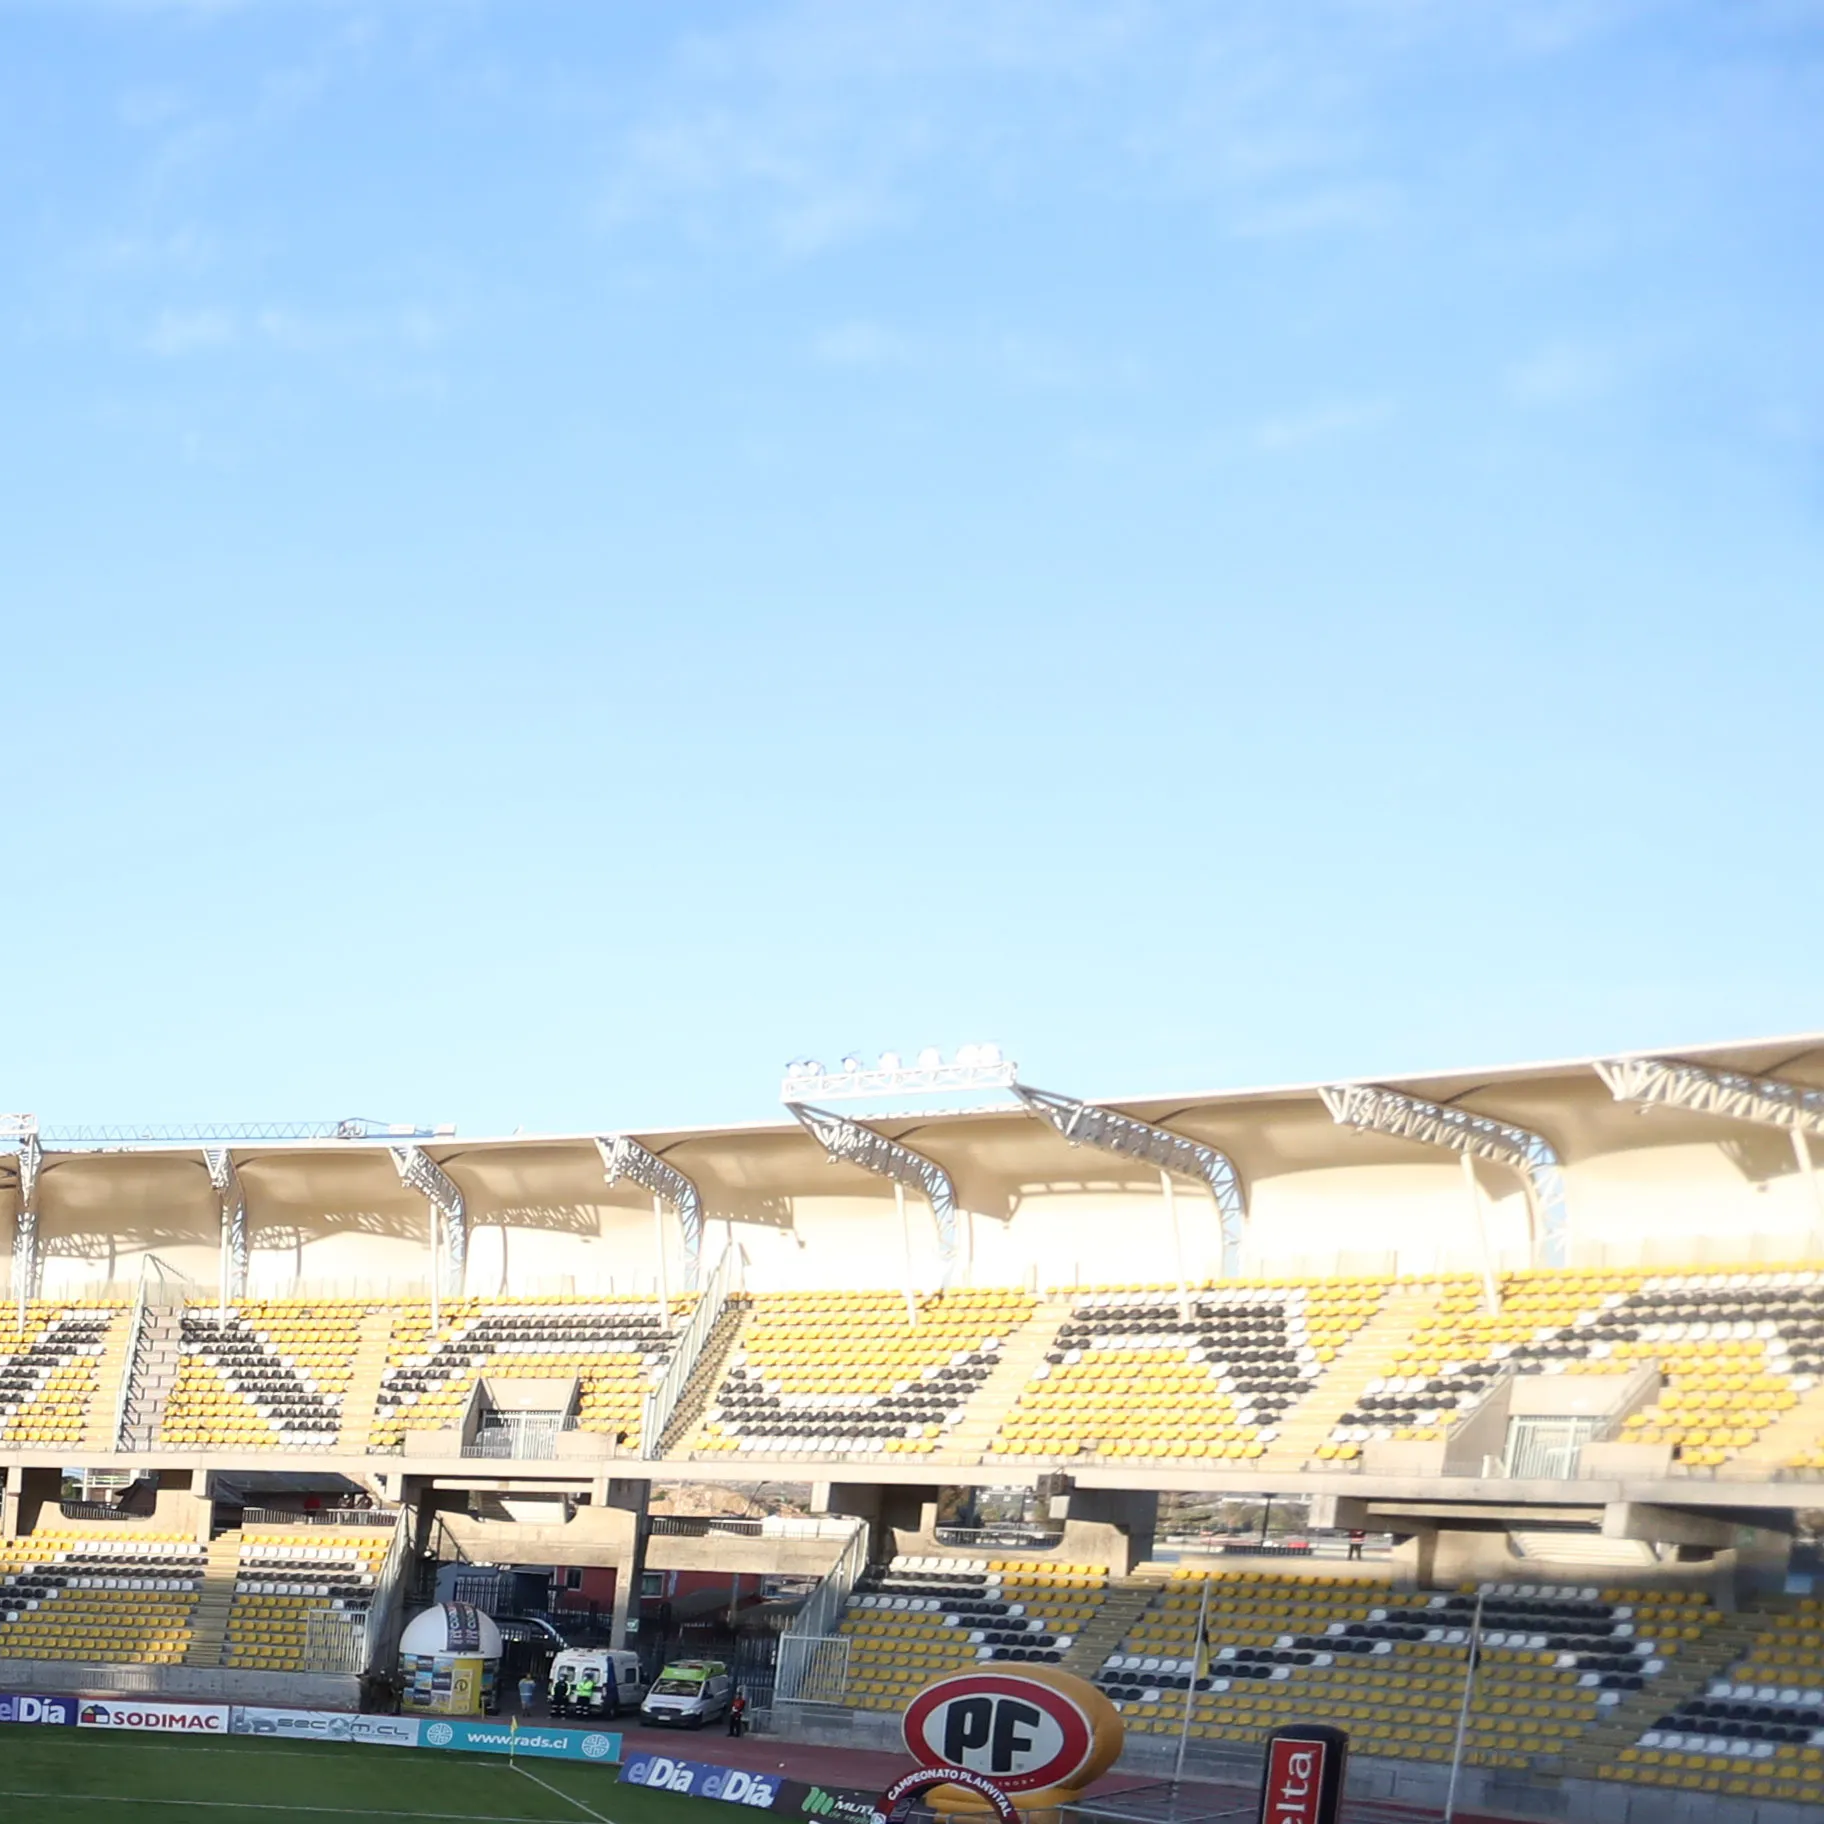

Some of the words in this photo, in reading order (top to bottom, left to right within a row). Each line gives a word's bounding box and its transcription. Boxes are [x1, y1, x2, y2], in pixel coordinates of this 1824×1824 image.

[113, 1711, 220, 1730] SODIMAC
[944, 1697, 1040, 1772] PF
[467, 1732, 568, 1749] www.rads.cl
[628, 1756, 694, 1793] elDía
[887, 1768, 958, 1801] CAMPEONATO
[959, 1769, 1011, 1817] PLANVITAL
